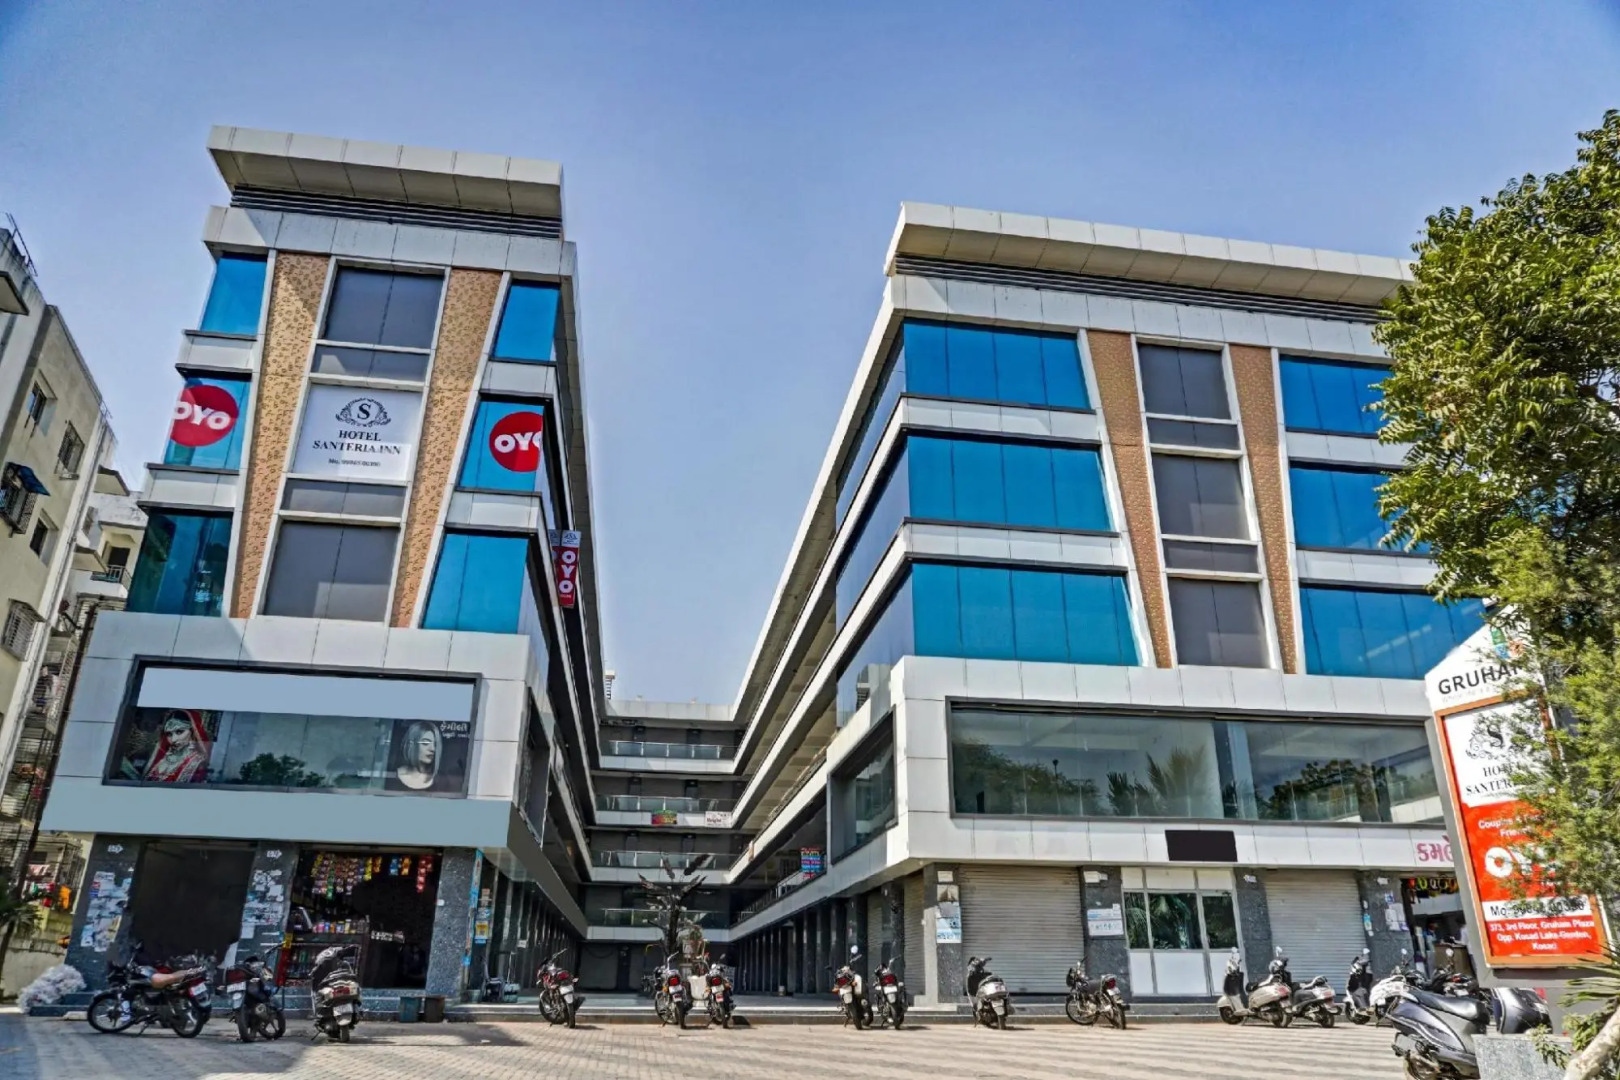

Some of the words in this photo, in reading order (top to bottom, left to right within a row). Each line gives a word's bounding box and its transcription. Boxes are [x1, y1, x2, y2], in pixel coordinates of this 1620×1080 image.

[173, 401, 231, 430] OYO
[339, 430, 381, 442] HOTEL
[559, 550, 576, 594] OYO
[1466, 778, 1517, 796] SANTER
